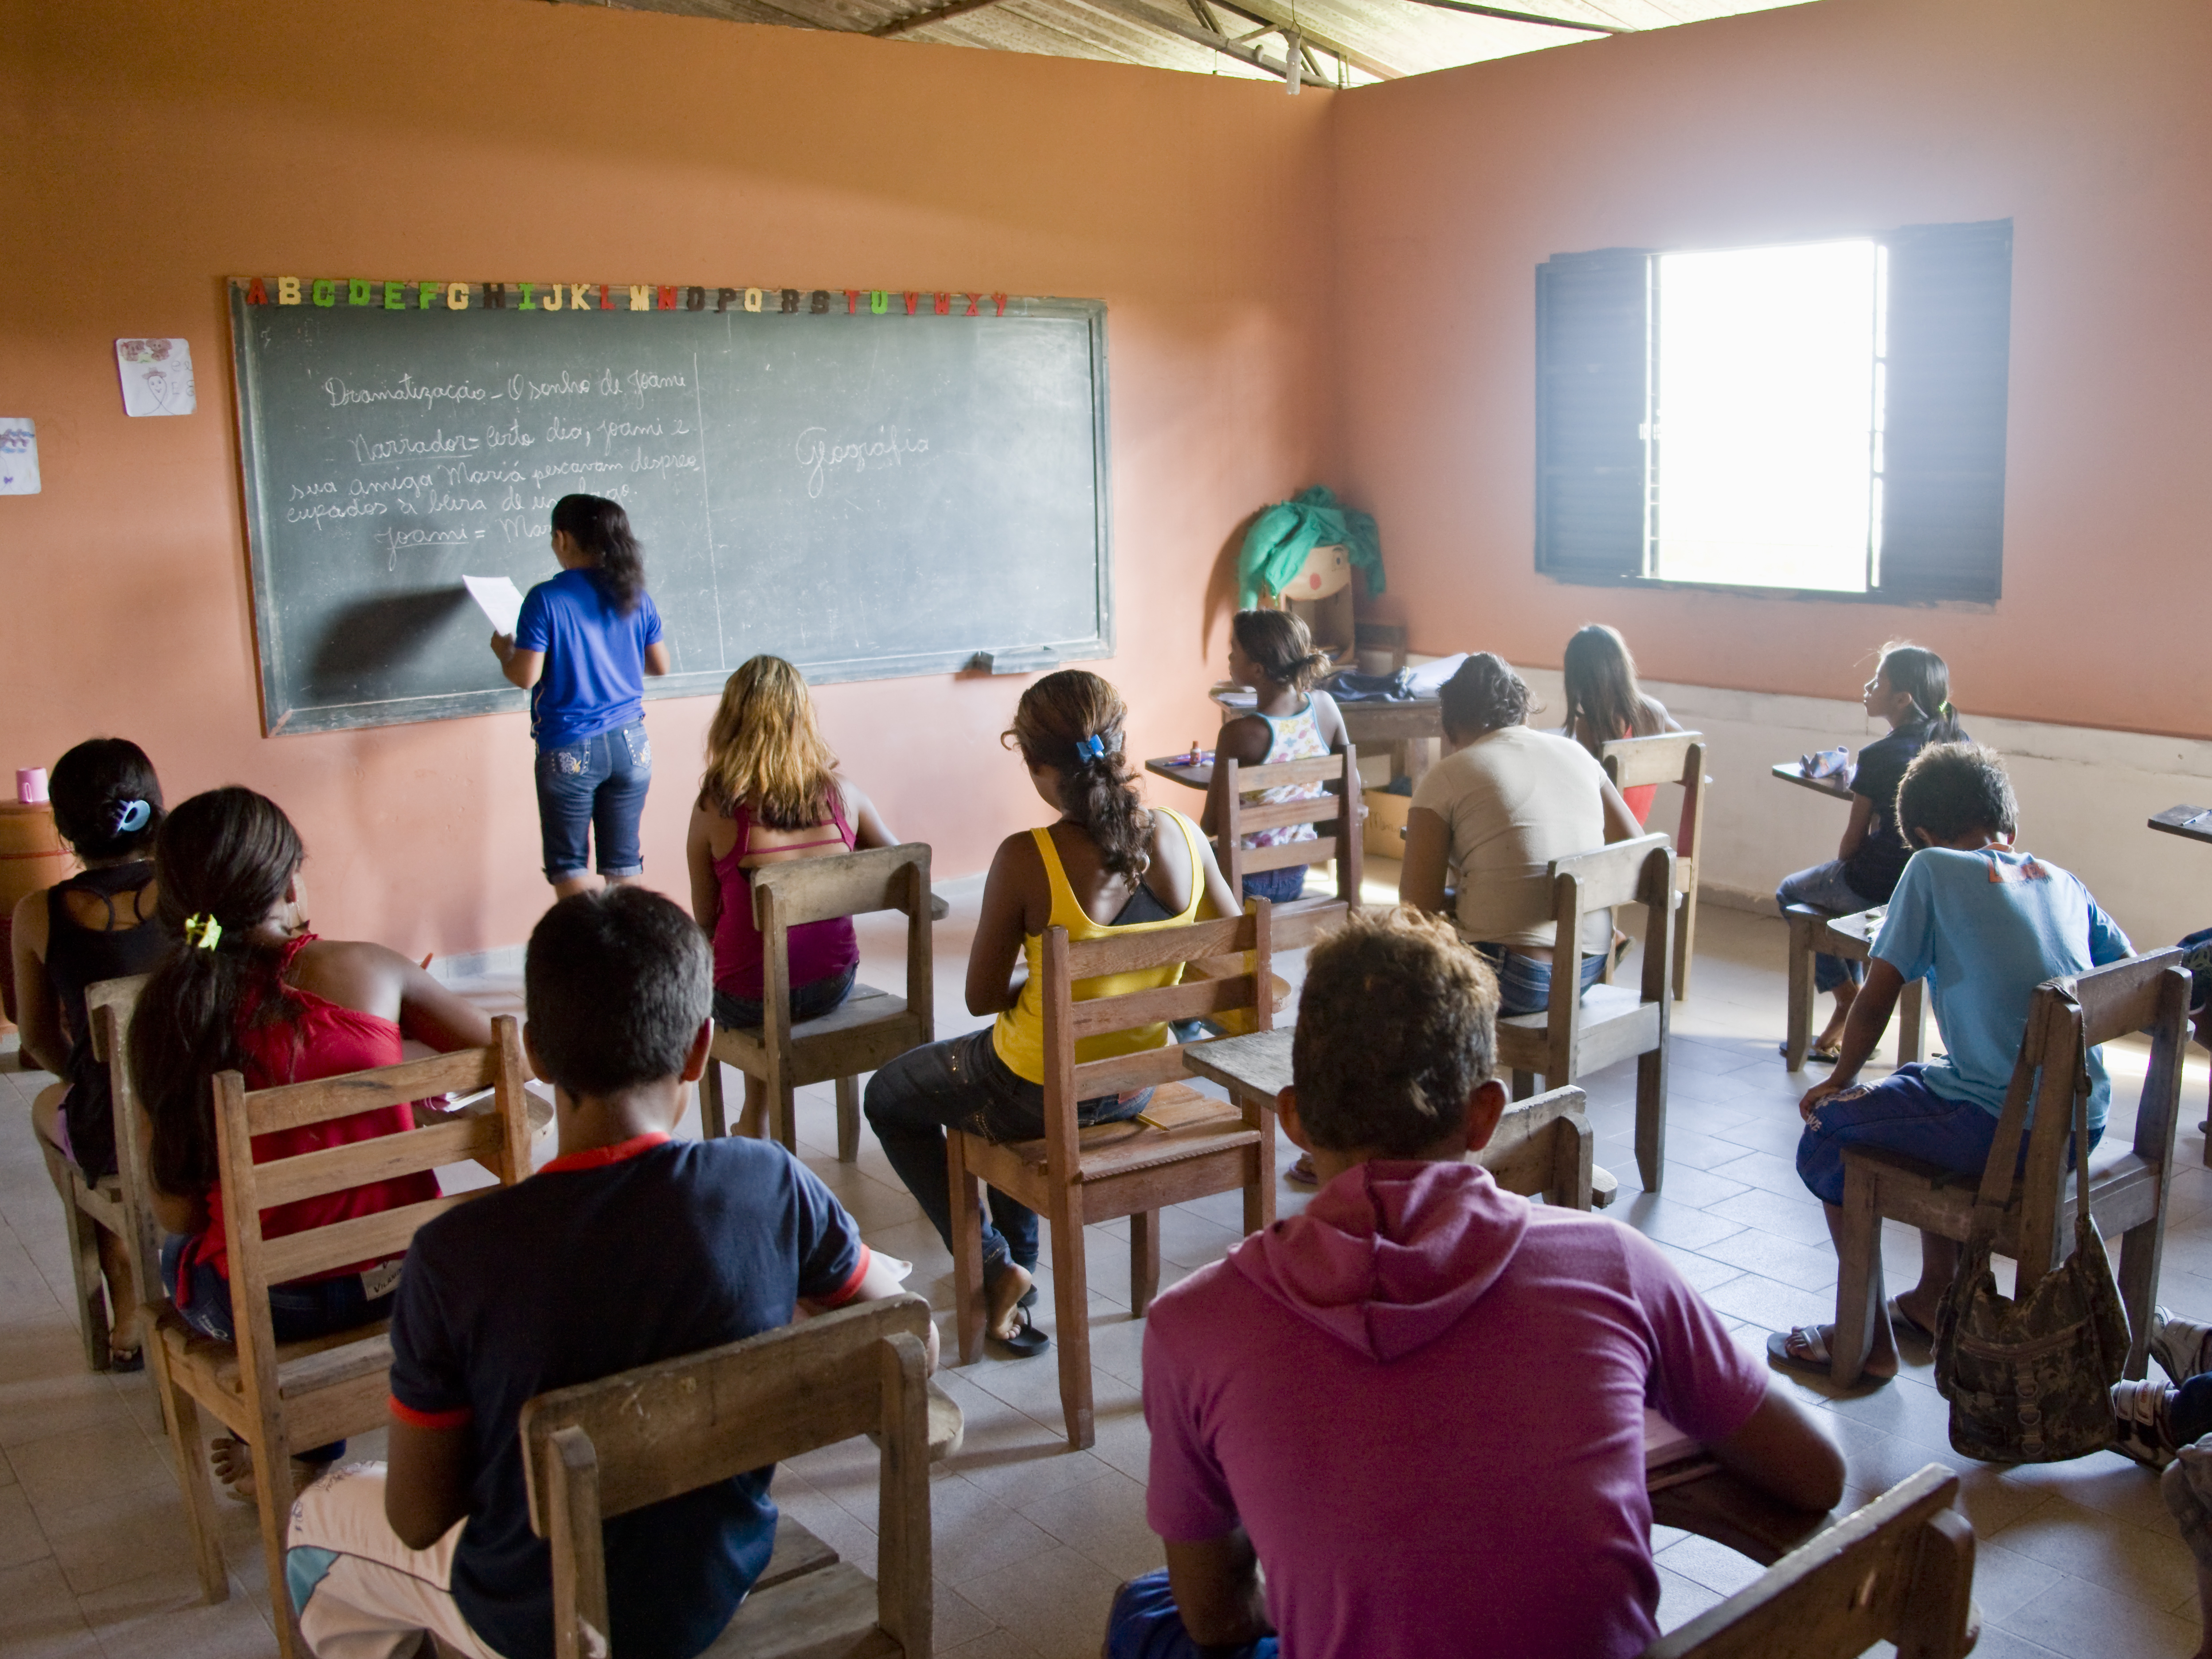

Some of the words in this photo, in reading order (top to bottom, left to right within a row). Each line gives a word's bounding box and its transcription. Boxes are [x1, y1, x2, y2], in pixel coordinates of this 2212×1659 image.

[247, 277, 268, 305] A
[278, 277, 301, 305] B
[313, 279, 335, 307] C
[349, 278, 371, 306] D
[385, 282, 406, 309] E
[420, 282, 439, 309] F
[447, 282, 470, 310] G
[483, 283, 505, 309] H
[518, 283, 536, 310] I
[544, 284, 562, 310] J
[572, 283, 591, 310] K
[601, 284, 615, 310] L
[630, 285, 650, 311] M
[658, 285, 677, 311] N
[687, 286, 705, 312] O
[717, 287, 737, 313] P
[744, 288, 762, 313] Q
[782, 289, 800, 314] R
[811, 290, 830, 314] S
[844, 290, 861, 314] T
[871, 290, 888, 314] U
[904, 291, 919, 315] V
[934, 292, 951, 315] W
[965, 293, 982, 316] X
[991, 292, 1007, 317] Y
[529, 370, 590, 400] sonho
[601, 368, 622, 395] de
[671, 419, 689, 435] e
[289, 481, 337, 501] sua
[350, 474, 433, 498] amiga
[531, 462, 623, 489] pescavam
[428, 489, 487, 514] beira
[501, 485, 525, 511] de
